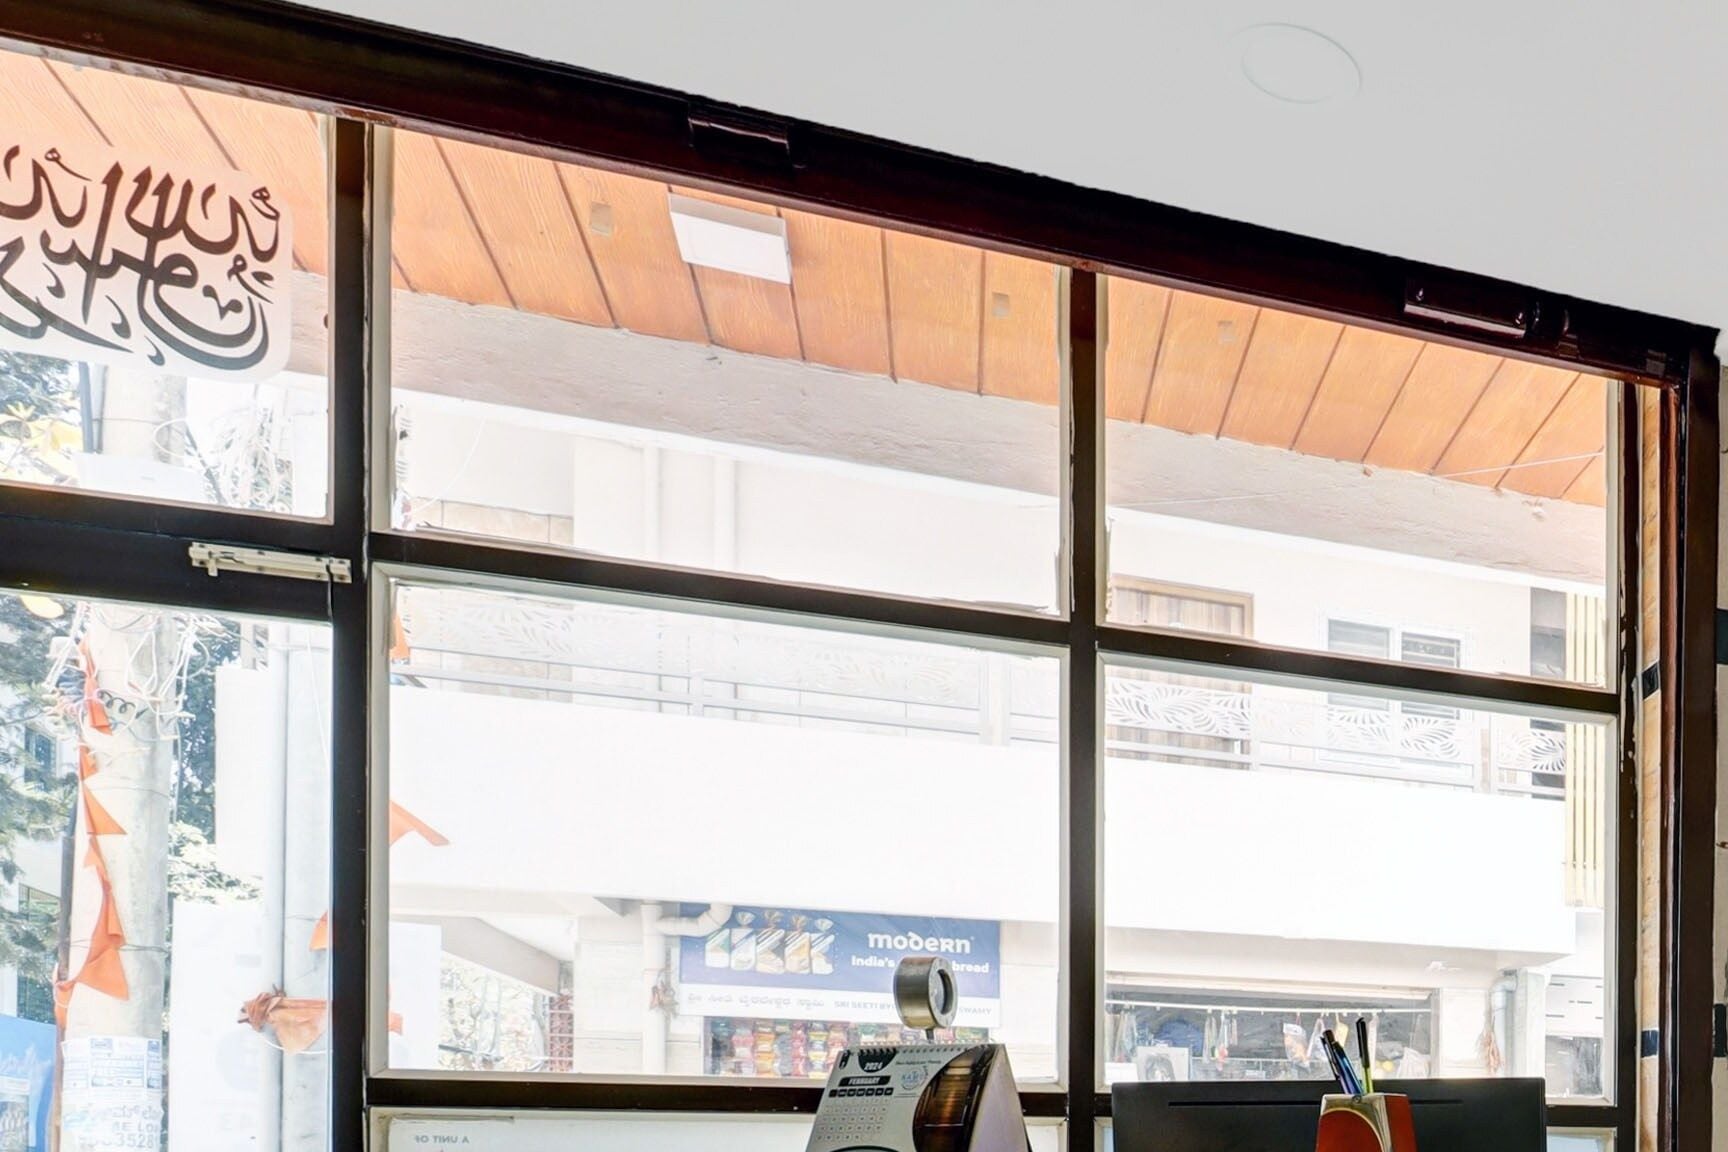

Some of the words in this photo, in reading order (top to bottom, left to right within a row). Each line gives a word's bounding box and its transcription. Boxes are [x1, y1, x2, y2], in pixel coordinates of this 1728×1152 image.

[852, 955, 896, 969] India's
[952, 961, 990, 974] bread
[863, 1062, 883, 1071] 2024
